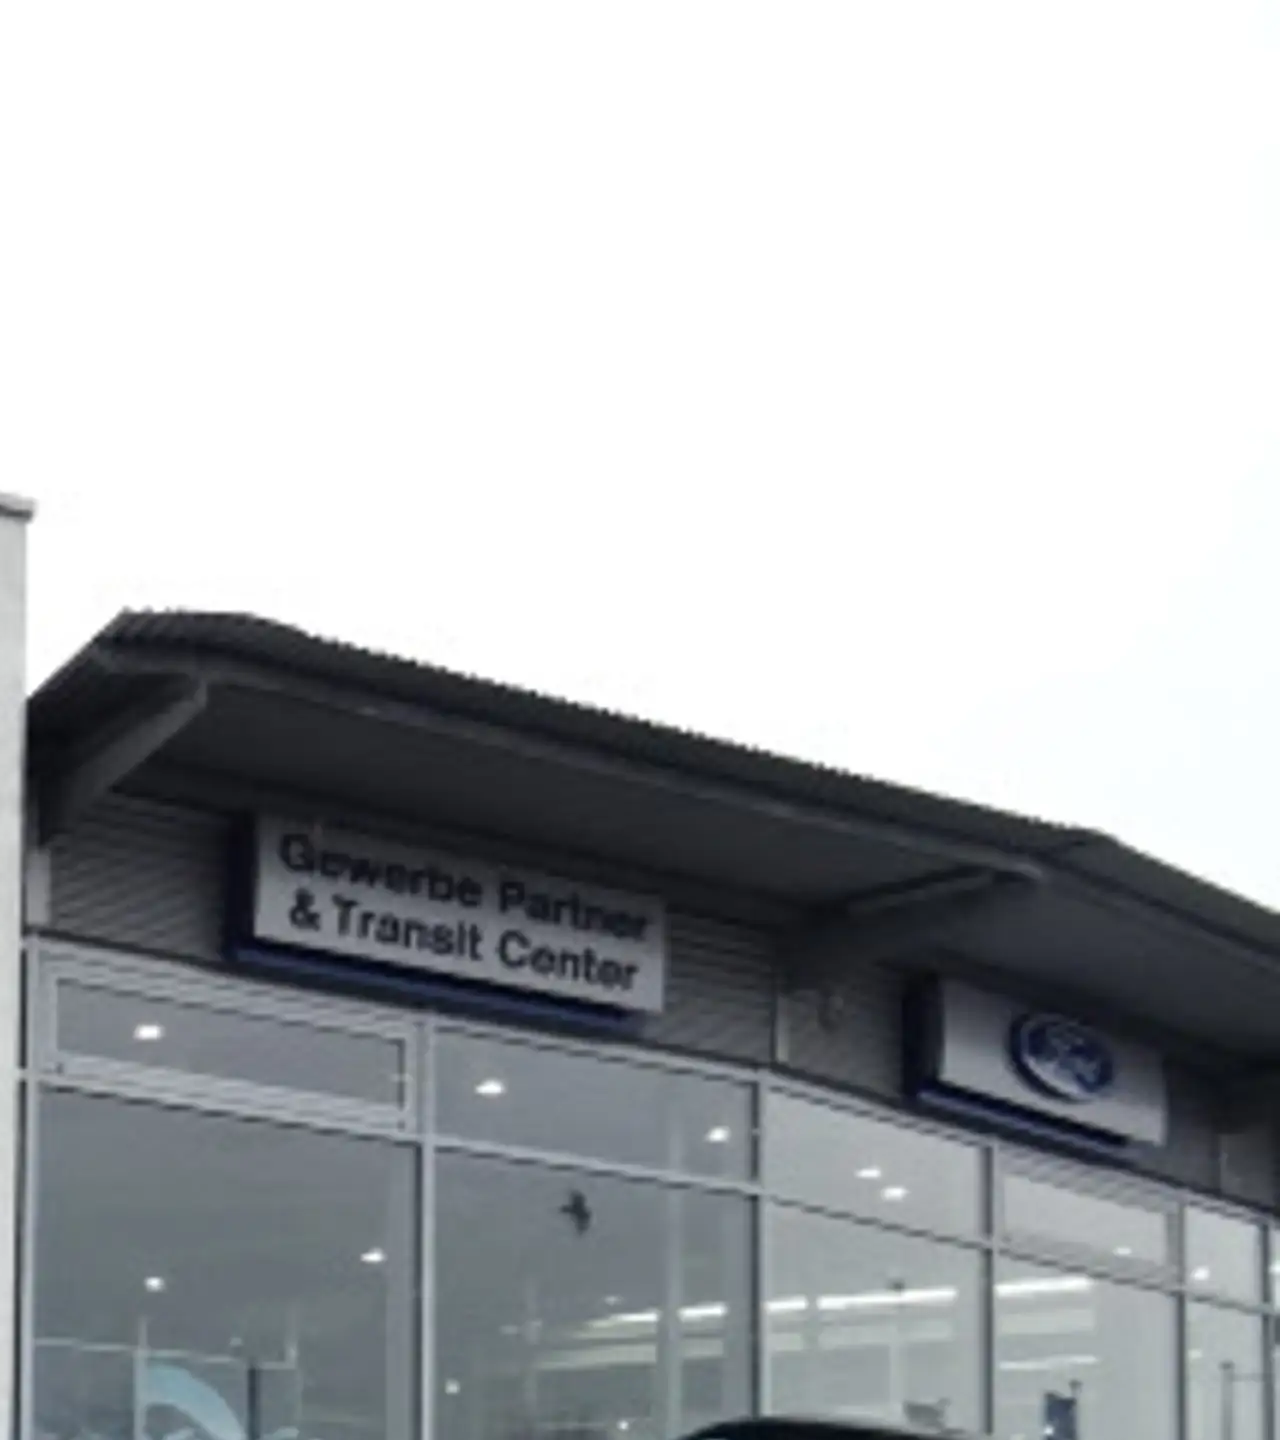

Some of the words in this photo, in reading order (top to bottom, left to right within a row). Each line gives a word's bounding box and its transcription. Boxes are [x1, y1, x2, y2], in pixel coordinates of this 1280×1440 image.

[279, 832, 483, 908] Gewerbe
[497, 880, 650, 941] Partner
[289, 888, 322, 932] &
[333, 894, 483, 962] Transit
[497, 929, 640, 991] Center
